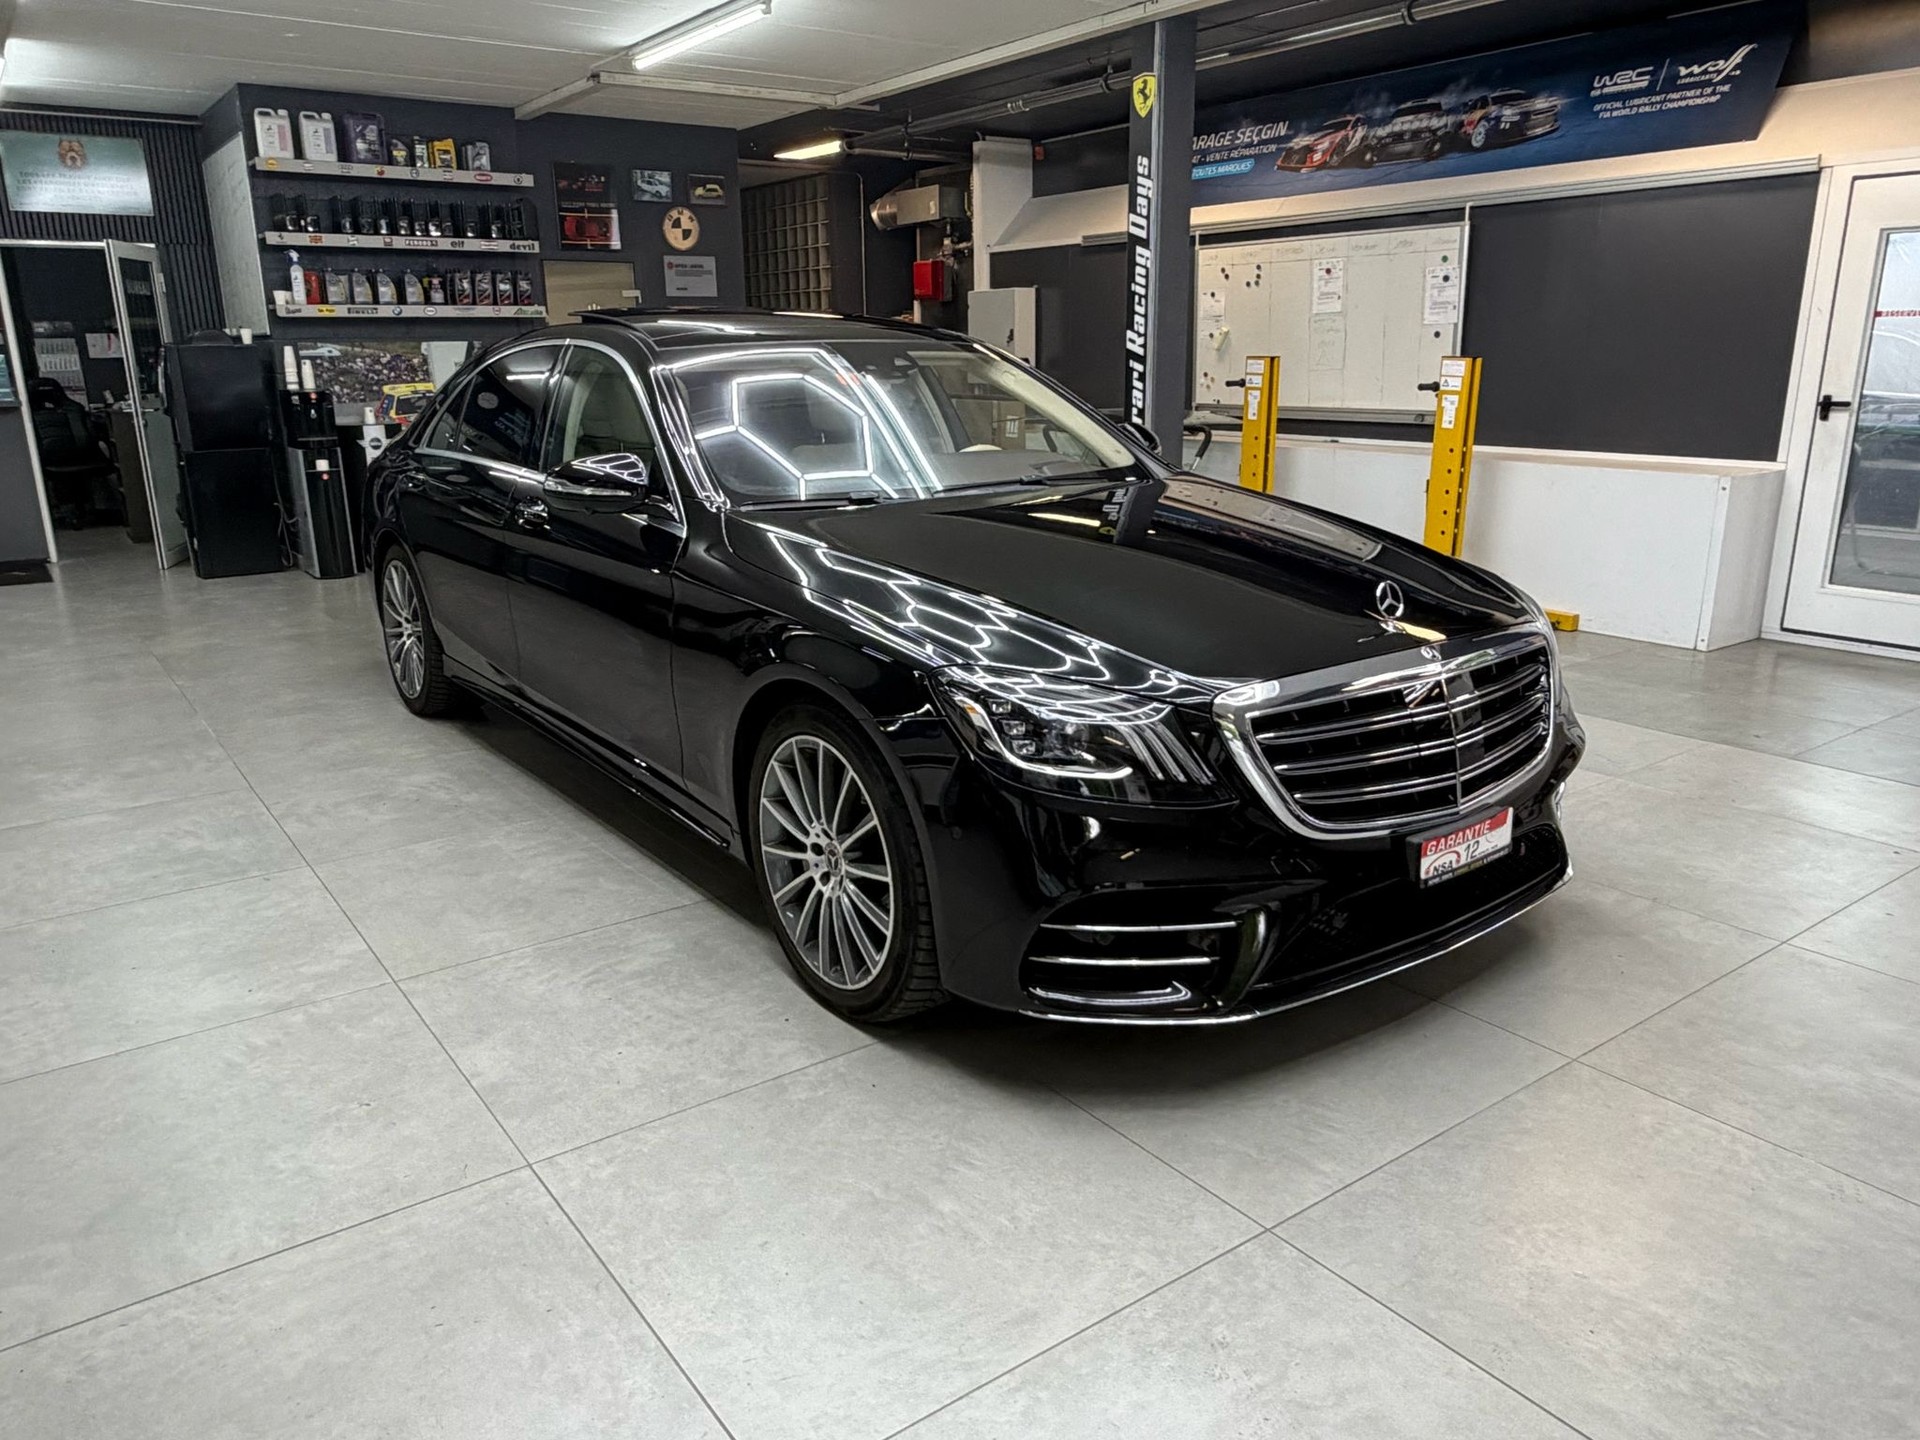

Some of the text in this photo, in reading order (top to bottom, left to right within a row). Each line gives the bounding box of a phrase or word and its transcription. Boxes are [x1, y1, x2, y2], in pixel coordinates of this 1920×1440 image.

[1593, 66, 1654, 88] WRC
[1593, 84, 1731, 112] OFFICIAL LUBRICANT PARTNER OF THE
[1599, 95, 1721, 119] FIA WORLD RALLY CHAMPIONSHIP
[1235, 121, 1289, 144] SEÇGIN
[1206, 151, 1230, 162] VENTE
[1230, 144, 1277, 158] RÉPARATION
[1217, 161, 1252, 173] MARQUES
[1129, 155, 1153, 239] Days
[450, 240, 465, 248] elf
[509, 243, 535, 251] devil
[1126, 245, 1151, 356] Racing
[1426, 820, 1491, 855] GARANTIE
[1464, 840, 1480, 861] 12
[1432, 860, 1454, 876] NSA
